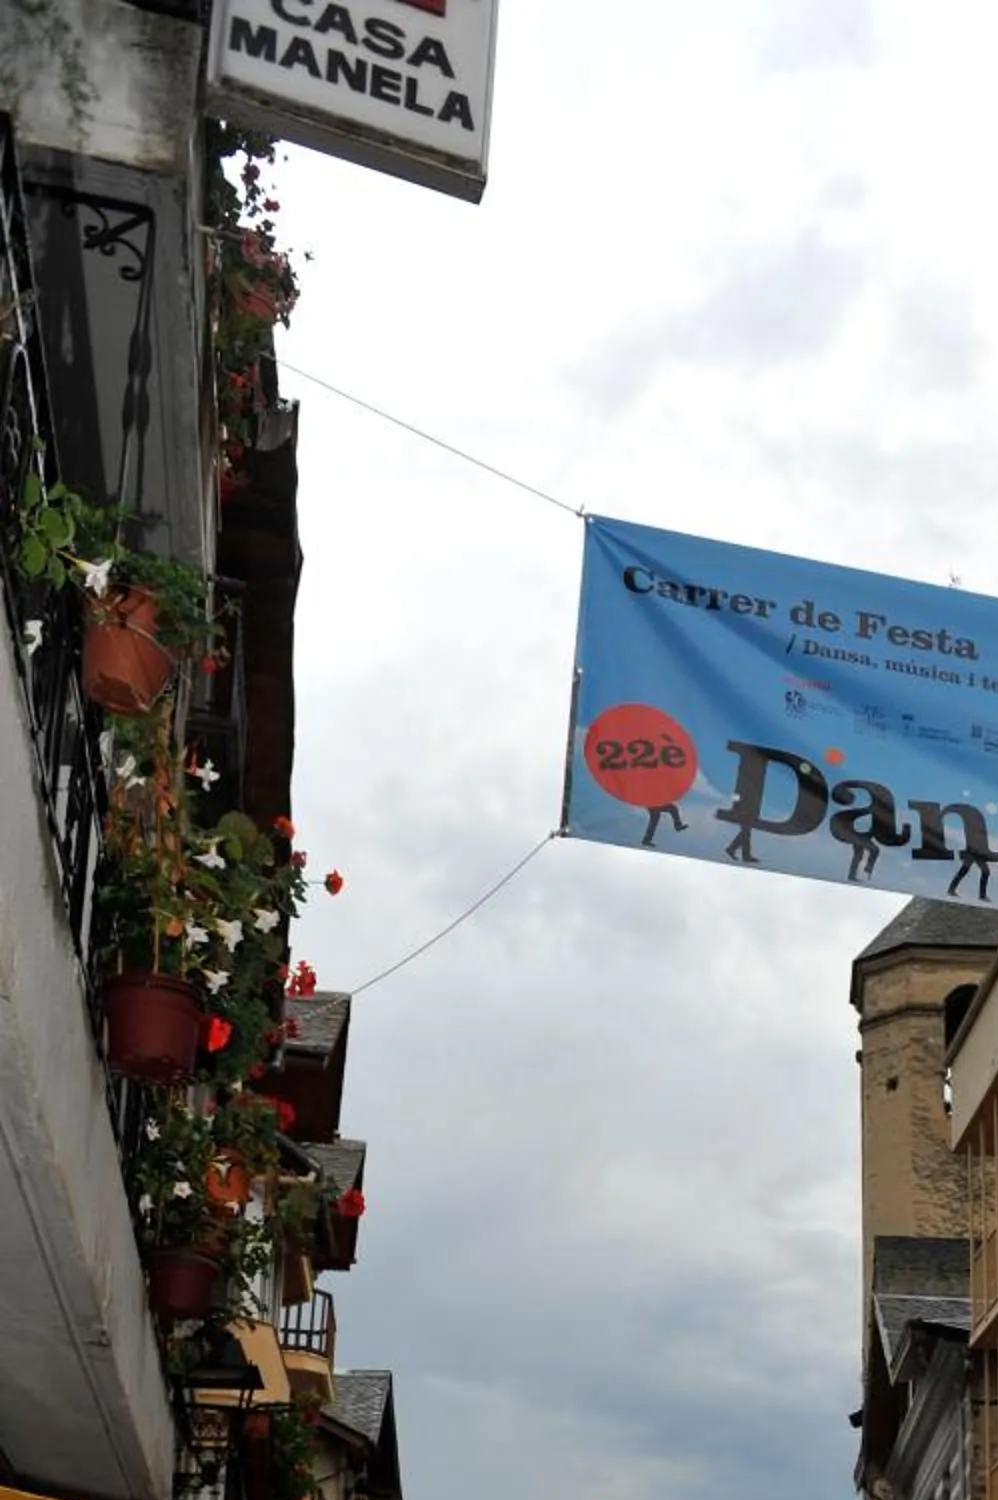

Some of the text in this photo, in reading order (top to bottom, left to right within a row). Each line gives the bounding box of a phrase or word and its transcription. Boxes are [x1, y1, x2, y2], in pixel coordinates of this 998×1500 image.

[229, 17, 475, 131] MANELA
[271, 0, 455, 78] CASA
[623, 566, 979, 660] Carrer de Festa
[803, 639, 878, 668] Dansa,
[884, 659, 963, 685] música
[967, 672, 976, 687] i
[595, 733, 686, 771] 22è
